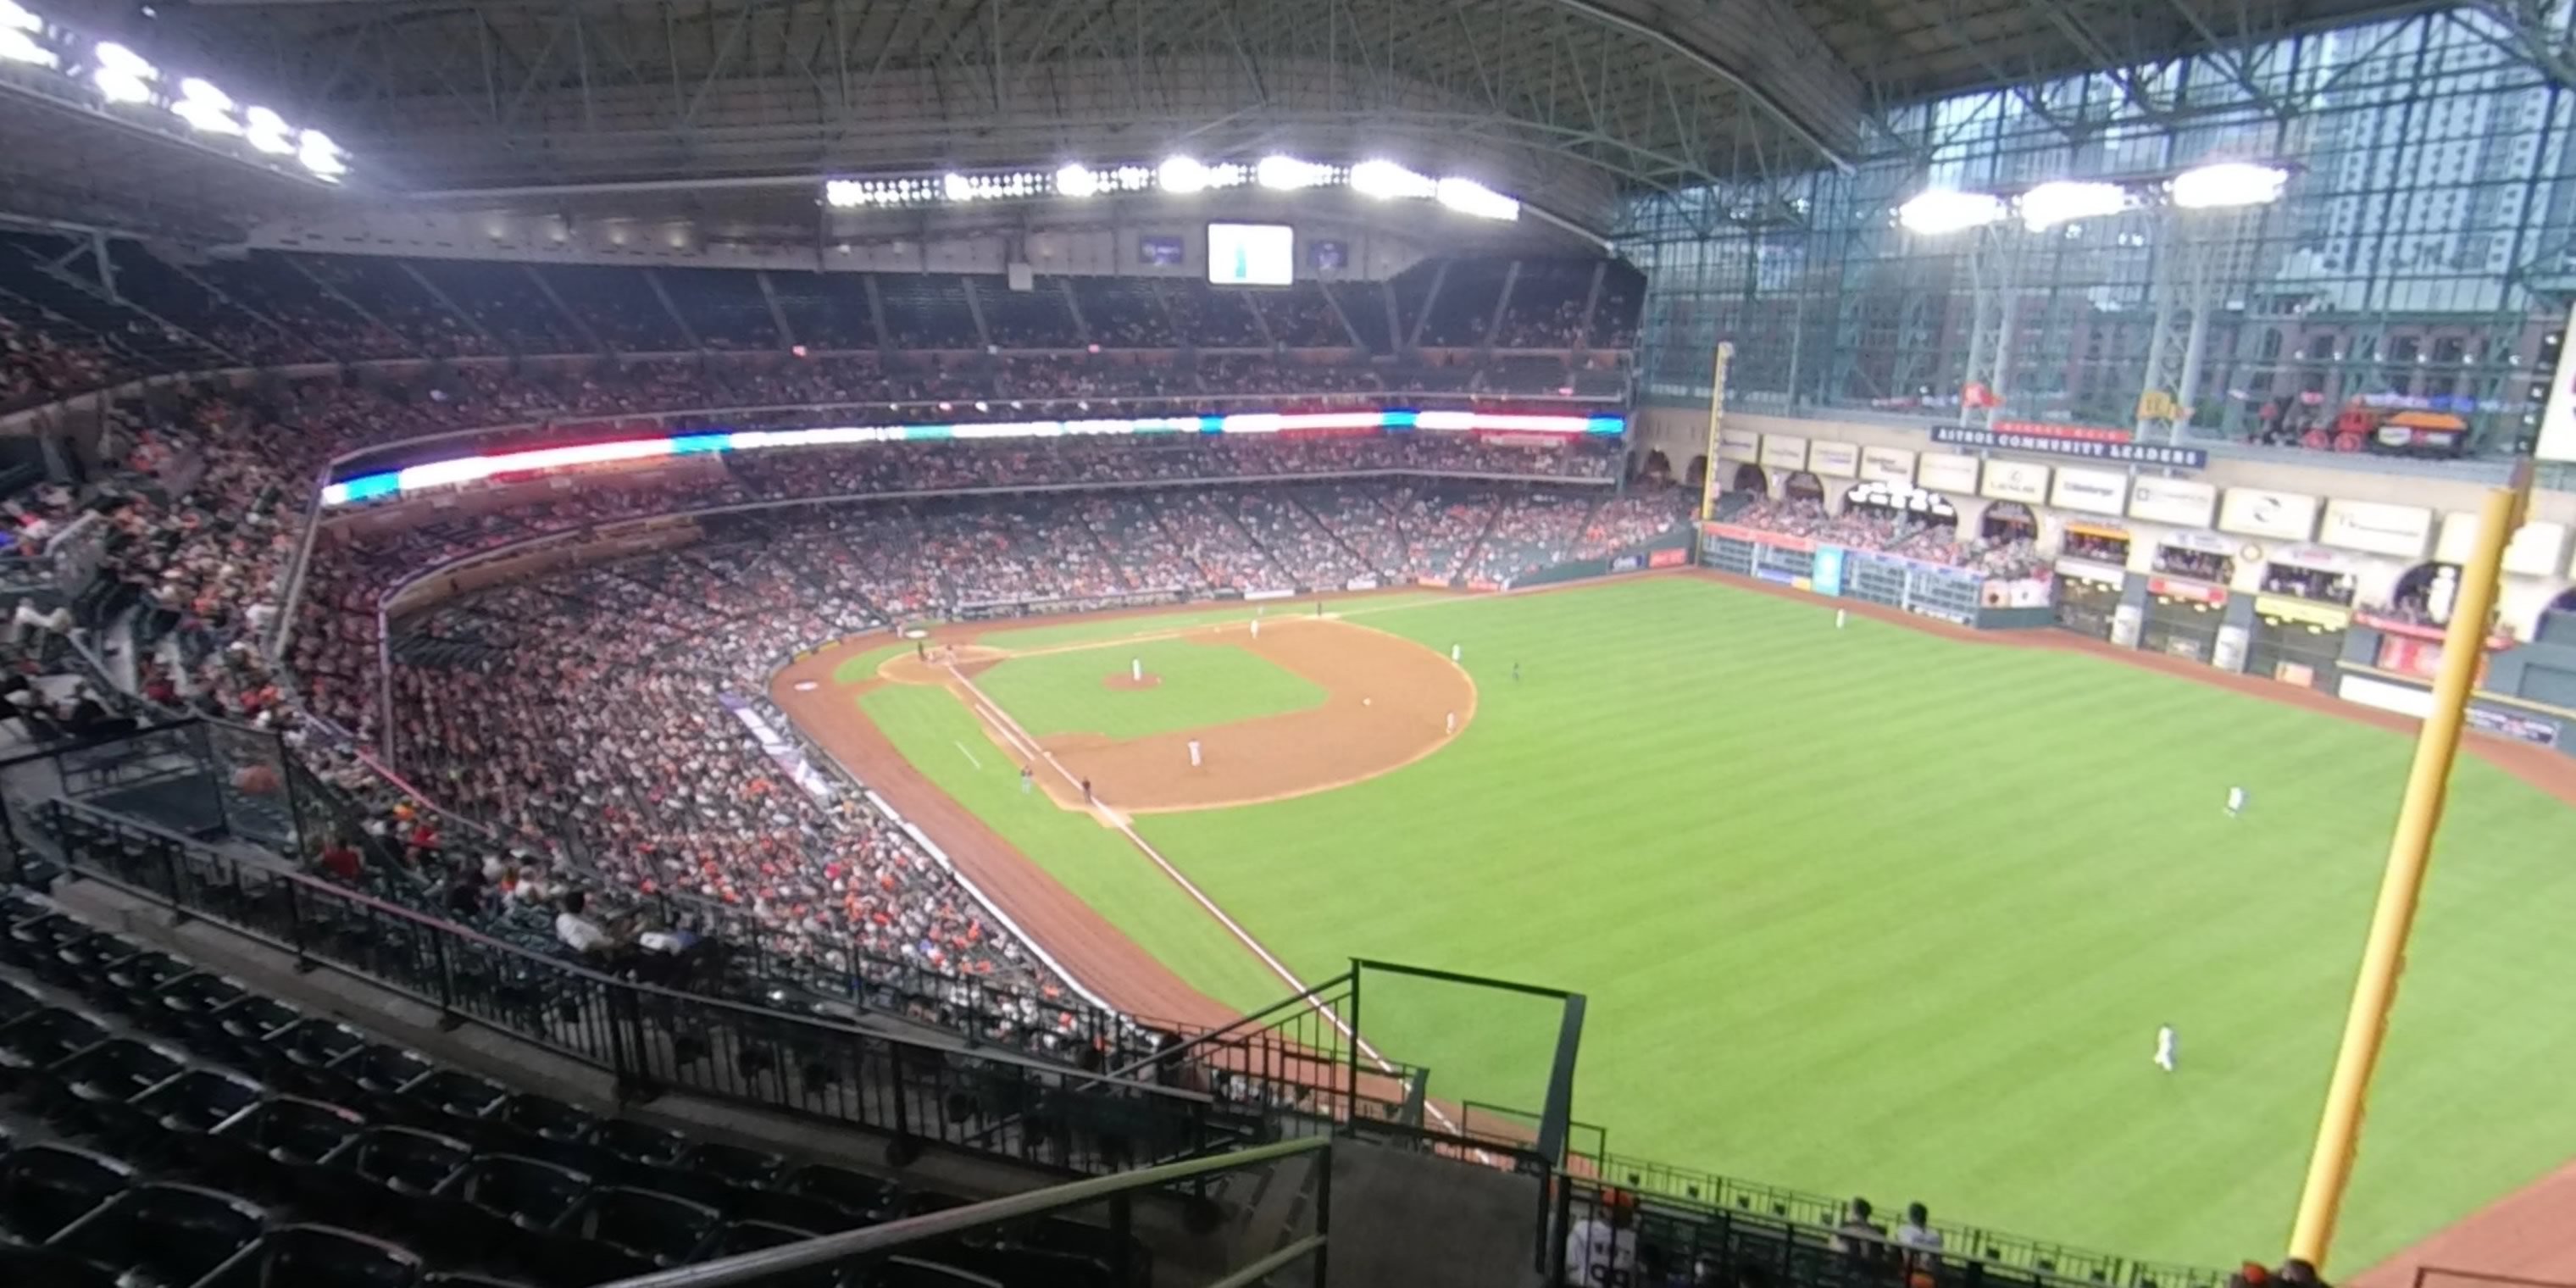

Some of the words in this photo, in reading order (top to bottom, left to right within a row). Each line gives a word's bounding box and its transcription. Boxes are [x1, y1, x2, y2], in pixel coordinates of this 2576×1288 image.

[1938, 427, 1994, 445] ASTROS
[1998, 433, 2103, 457] COMMUNITY
[2110, 444, 2196, 465] LEADERS
